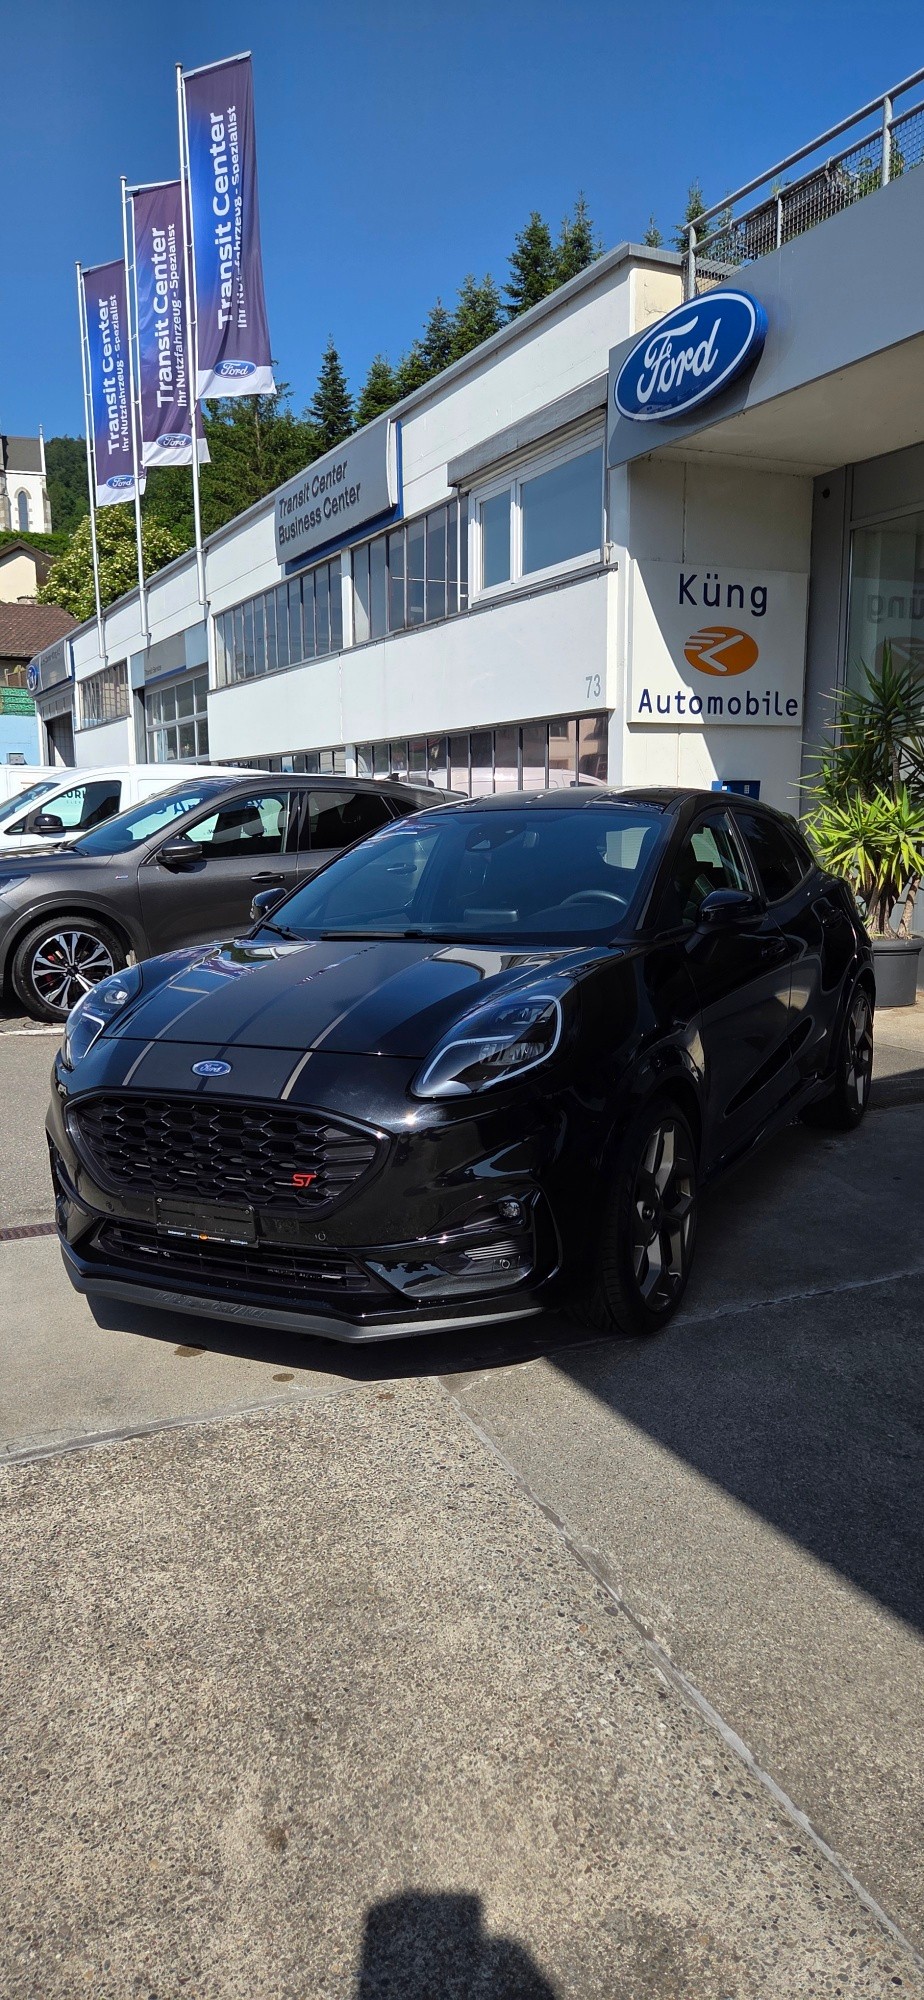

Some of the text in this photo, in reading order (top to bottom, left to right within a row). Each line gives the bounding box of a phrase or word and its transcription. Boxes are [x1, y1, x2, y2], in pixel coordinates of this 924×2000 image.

[227, 105, 240, 186] Spezialist
[209, 112, 234, 330] Transit Center
[167, 223, 179, 289] Spezialist
[109, 294, 121, 352] Spezialist
[151, 227, 175, 408] Transit Center
[237, 309, 248, 329] Ihr
[172, 299, 187, 389] Nutzfahrzeug
[220, 362, 249, 376] Ford
[636, 316, 722, 404] Ford
[98, 298, 120, 456] Transit Center
[116, 359, 129, 435] Nutzfahrzeug
[177, 389, 188, 407] Ihr
[121, 435, 130, 452] Ihr
[162, 434, 187, 447] Ford
[112, 477, 133, 488] Ford
[279, 460, 348, 518] Transit Center
[278, 483, 361, 545] Business Center
[678, 573, 769, 617] Küng
[584, 673, 602, 699] 73
[637, 688, 799, 717] Automobile
[199, 1063, 223, 1073] Ford
[292, 1173, 318, 1187] ST
